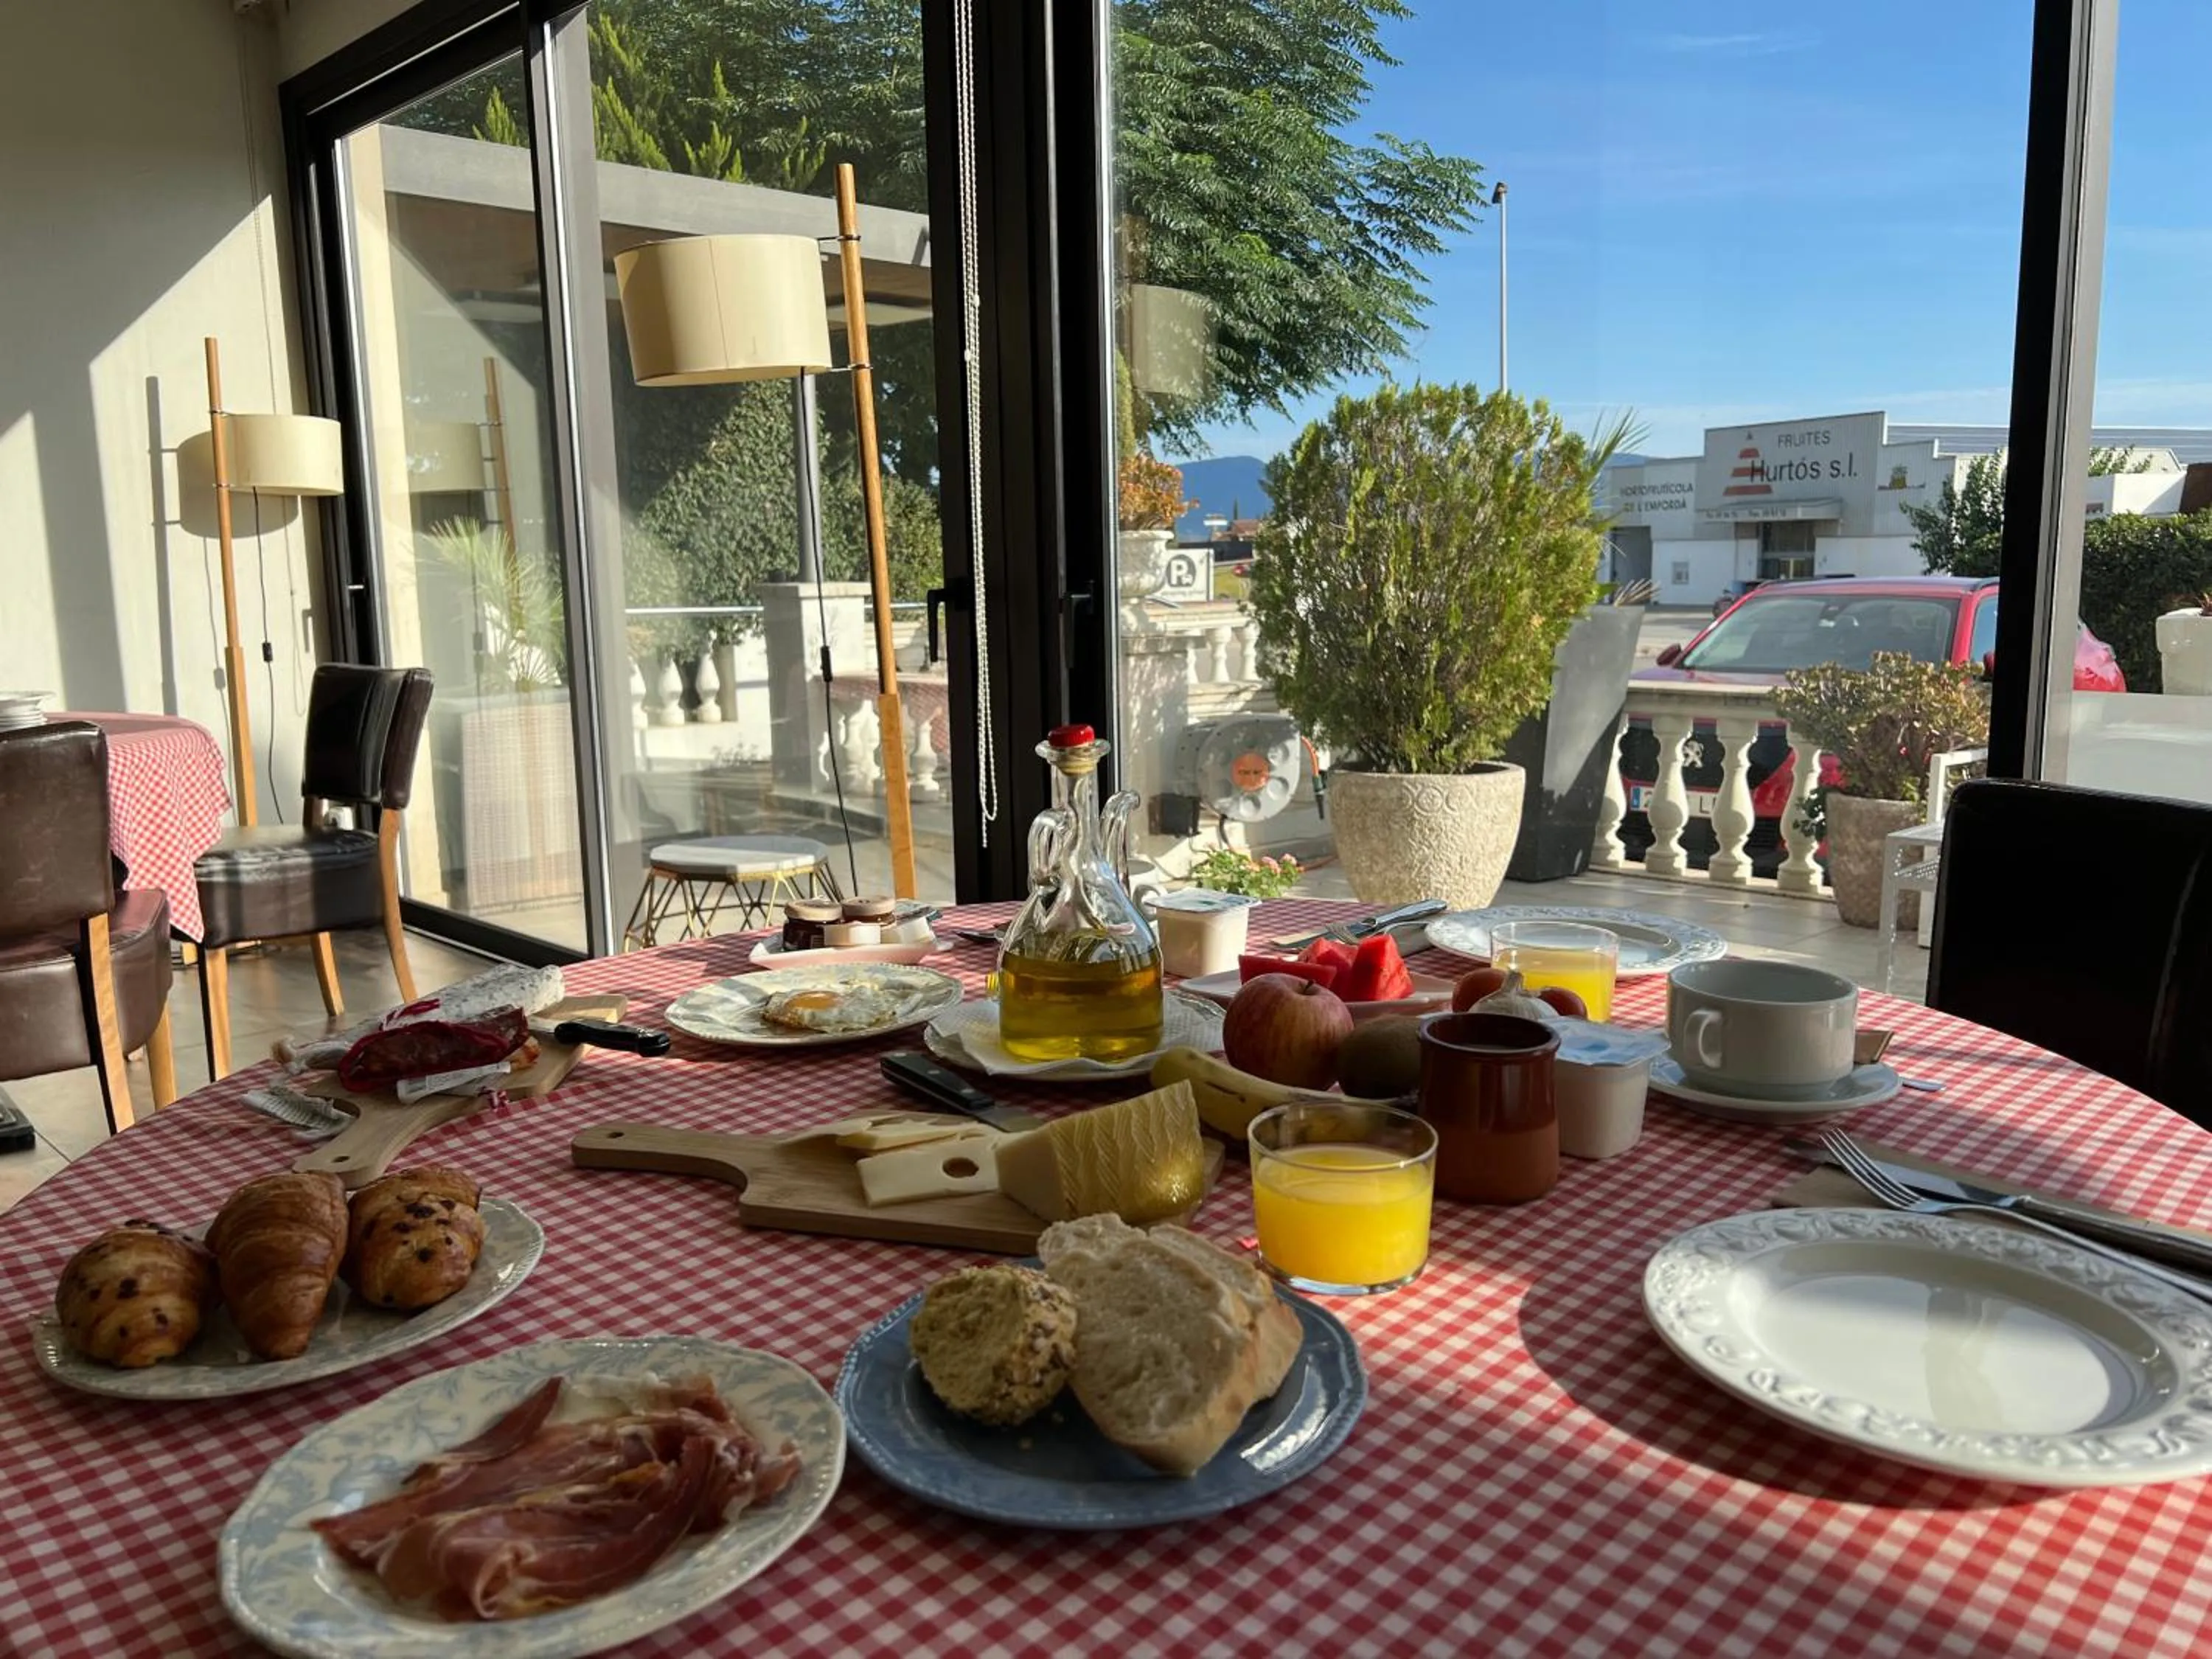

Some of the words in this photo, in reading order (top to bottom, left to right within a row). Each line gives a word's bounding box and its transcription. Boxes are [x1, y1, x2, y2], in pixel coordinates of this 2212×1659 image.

[1778, 431, 1832, 448] FRUITES
[1750, 456, 1821, 483] Hurtós
[1829, 451, 1858, 479] s.l.
